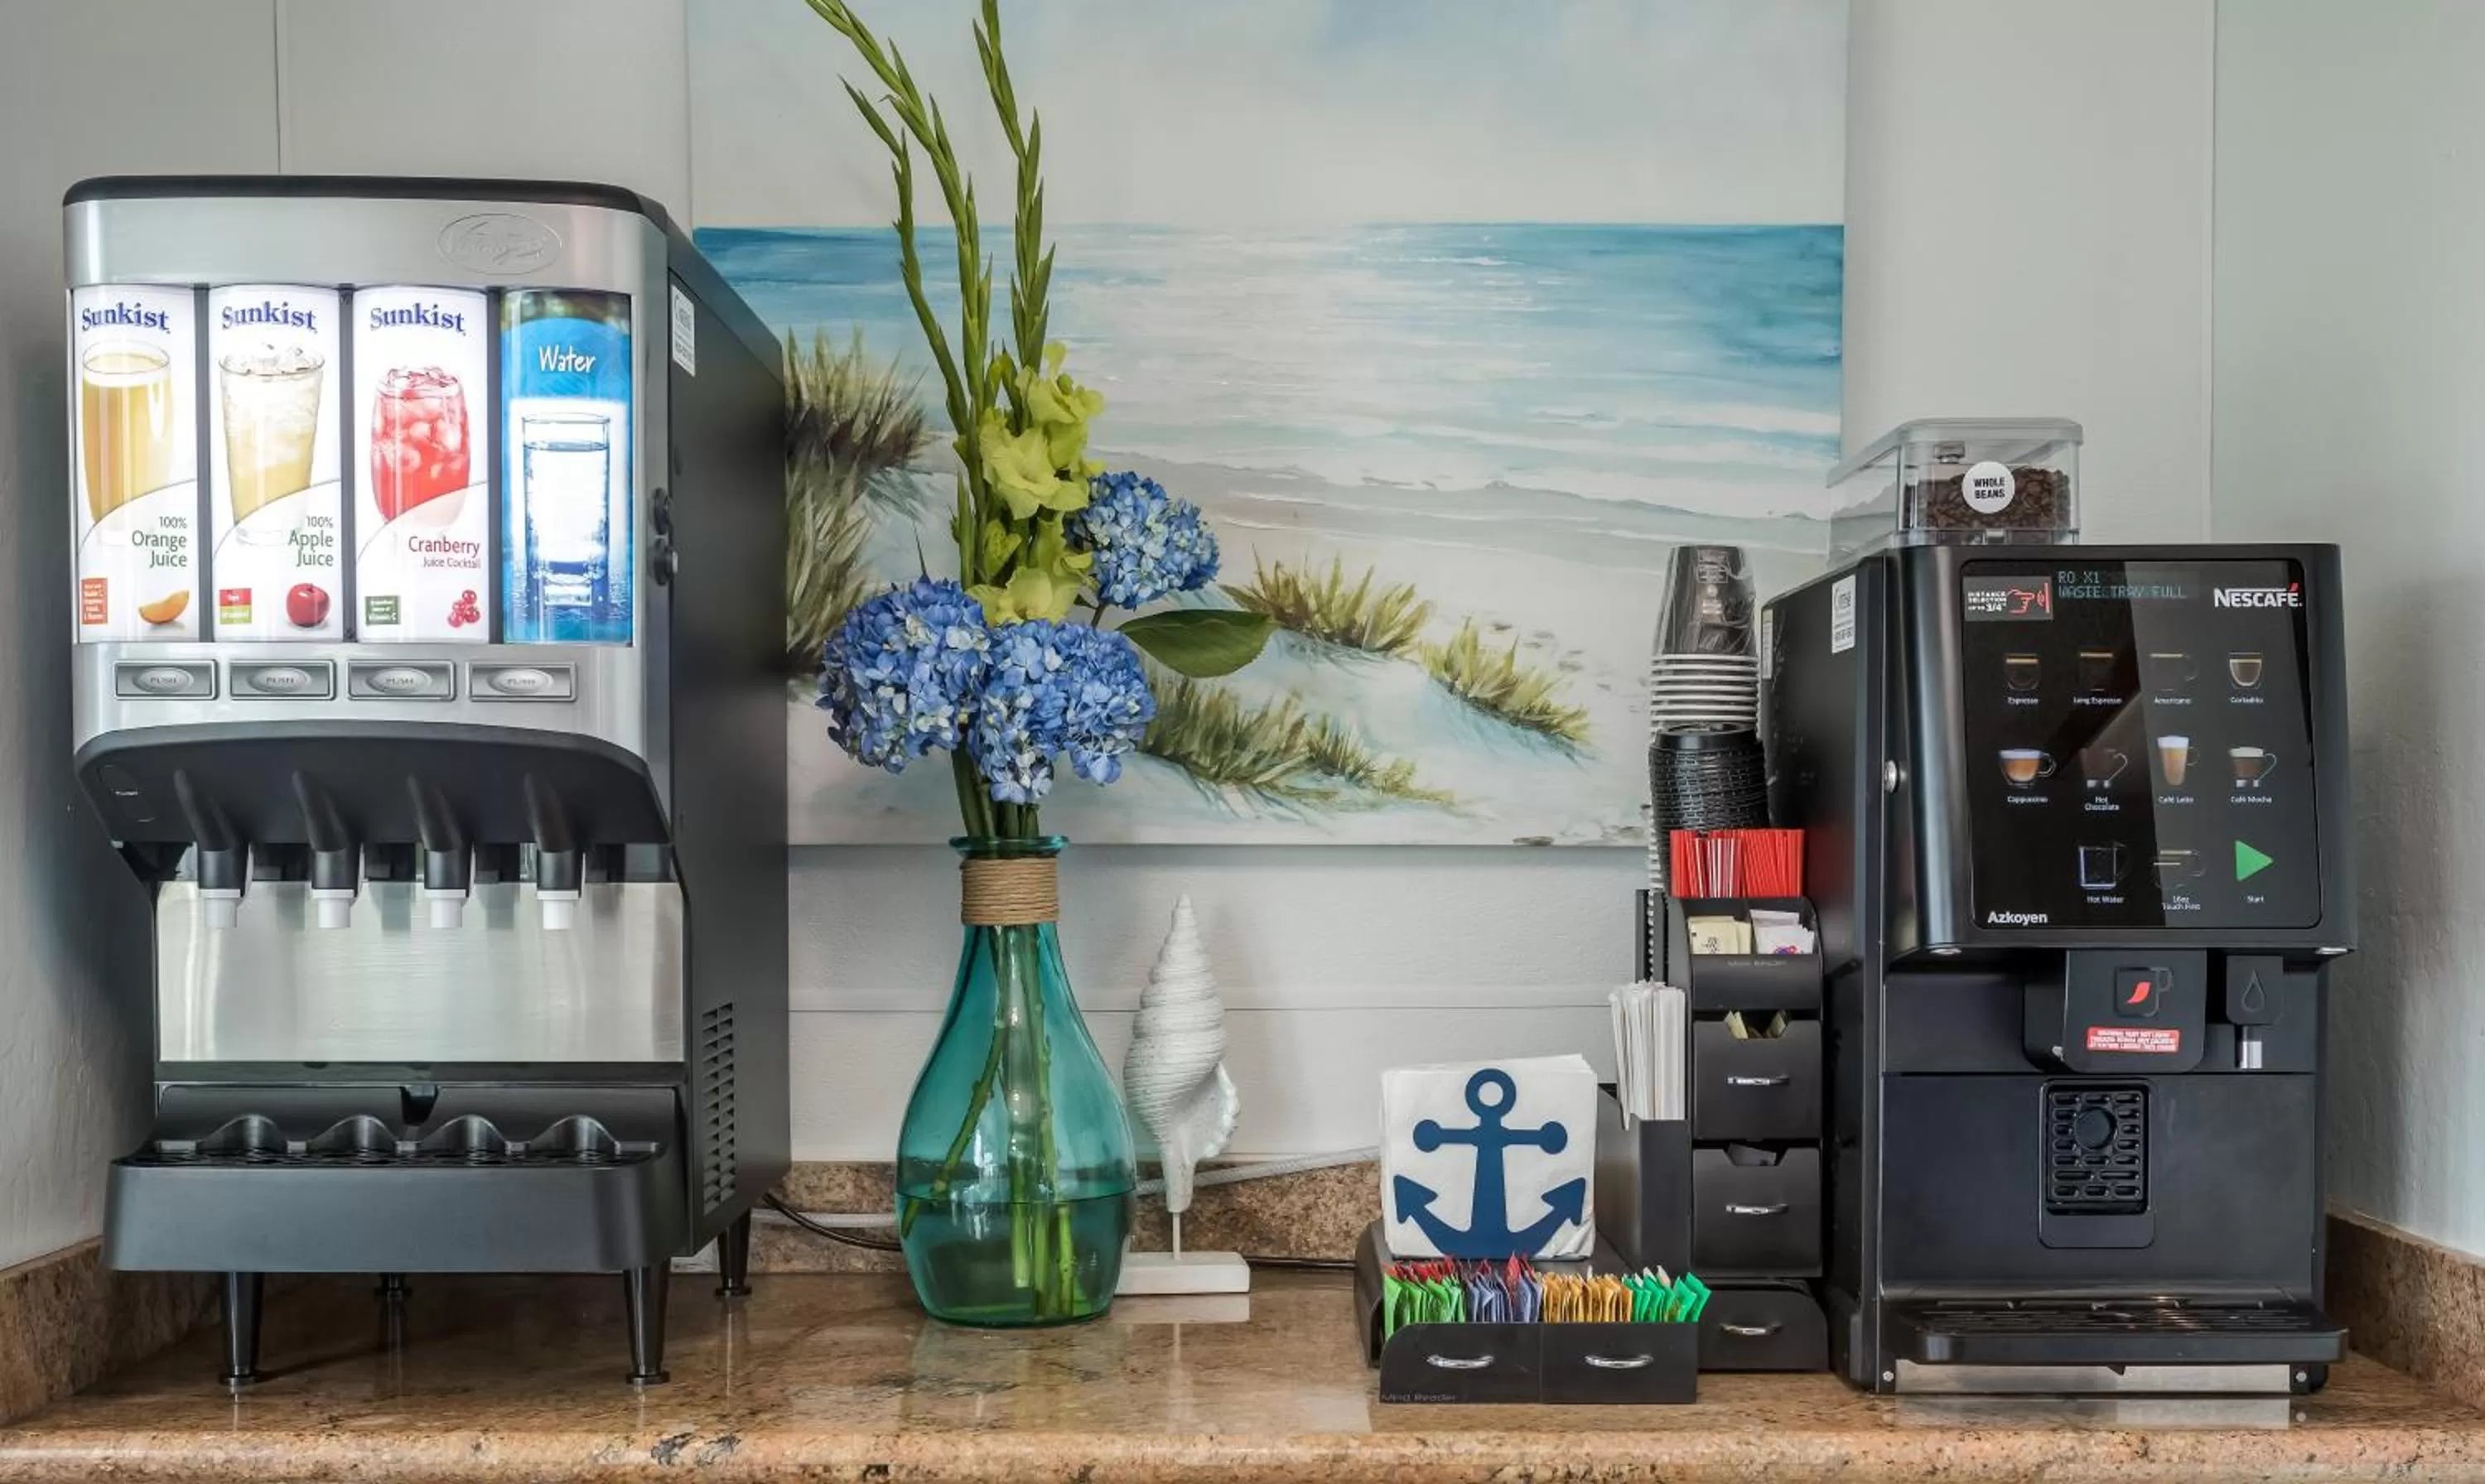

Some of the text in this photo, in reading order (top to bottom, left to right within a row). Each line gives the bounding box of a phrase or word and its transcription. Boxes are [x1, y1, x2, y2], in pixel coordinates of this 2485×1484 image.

[82, 301, 170, 331] Sunkist
[222, 301, 317, 330] Sunkist
[370, 302, 465, 332] Sunkist
[539, 344, 596, 372] Water
[1973, 477, 2005, 488] WHOLE
[1975, 489, 2005, 499] BEANS
[159, 516, 187, 528] 100%
[306, 516, 334, 528] 100%
[132, 530, 187, 552] Orange
[288, 530, 334, 550] Apple
[408, 536, 480, 557] Cranberry
[150, 551, 187, 568] Juice
[296, 550, 334, 567] Juice
[423, 556, 446, 568] Juice
[1988, 911, 2048, 926] Azkoyen
